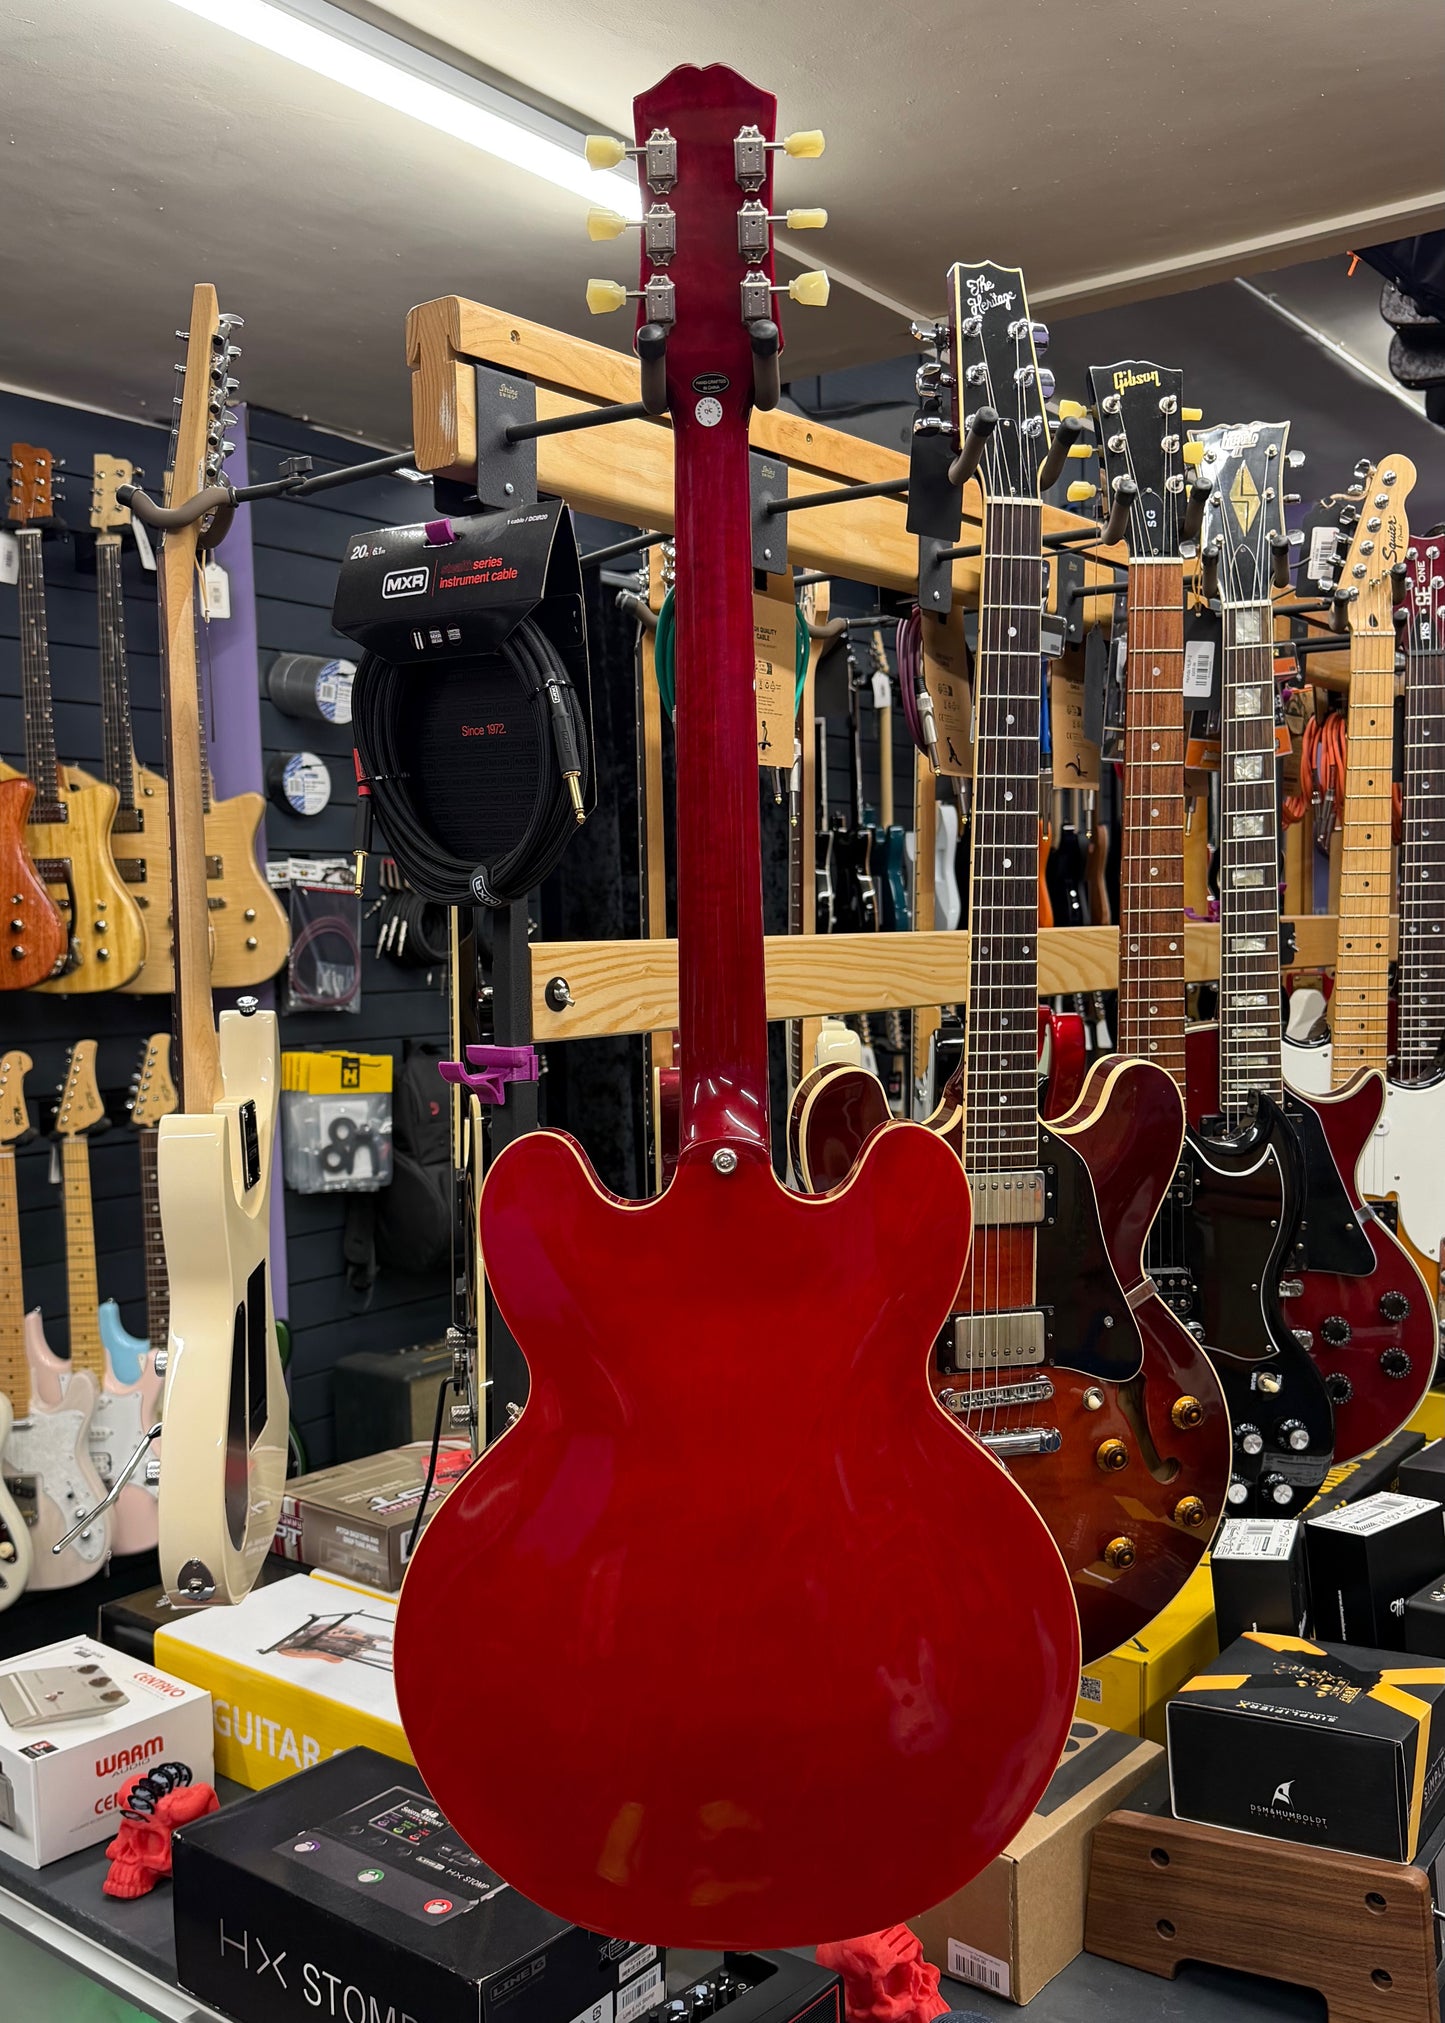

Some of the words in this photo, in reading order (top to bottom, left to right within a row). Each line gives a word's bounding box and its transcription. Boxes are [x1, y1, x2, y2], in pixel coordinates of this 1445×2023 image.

[966, 275, 995, 296] The
[967, 291, 1017, 315] Heritage
[1113, 369, 1161, 395] Gibson
[1146, 510, 1157, 527] SG
[1382, 515, 1398, 563] Squier
[473, 556, 503, 570] series
[1417, 560, 1426, 582] ONE
[386, 573, 424, 592] MXR
[439, 571, 490, 589] instrument
[491, 567, 518, 581] cable
[756, 633, 770, 642] CABLE
[759, 626, 777, 635] QUALITY
[1420, 621, 1431, 640] PRS
[461, 726, 484, 736] Since
[213, 1700, 321, 1770] GUITAR
[95, 1735, 164, 1778] WARM
[111, 1759, 151, 1779] AUDIO
[1249, 1804, 1328, 1825] DSM&HUMBOLDT
[446, 1868, 464, 1881] HX
[463, 1873, 491, 1890] STOMP
[218, 1917, 288, 1990] HX
[302, 1962, 418, 2023] STOM
[492, 1962, 531, 1997] LINE
